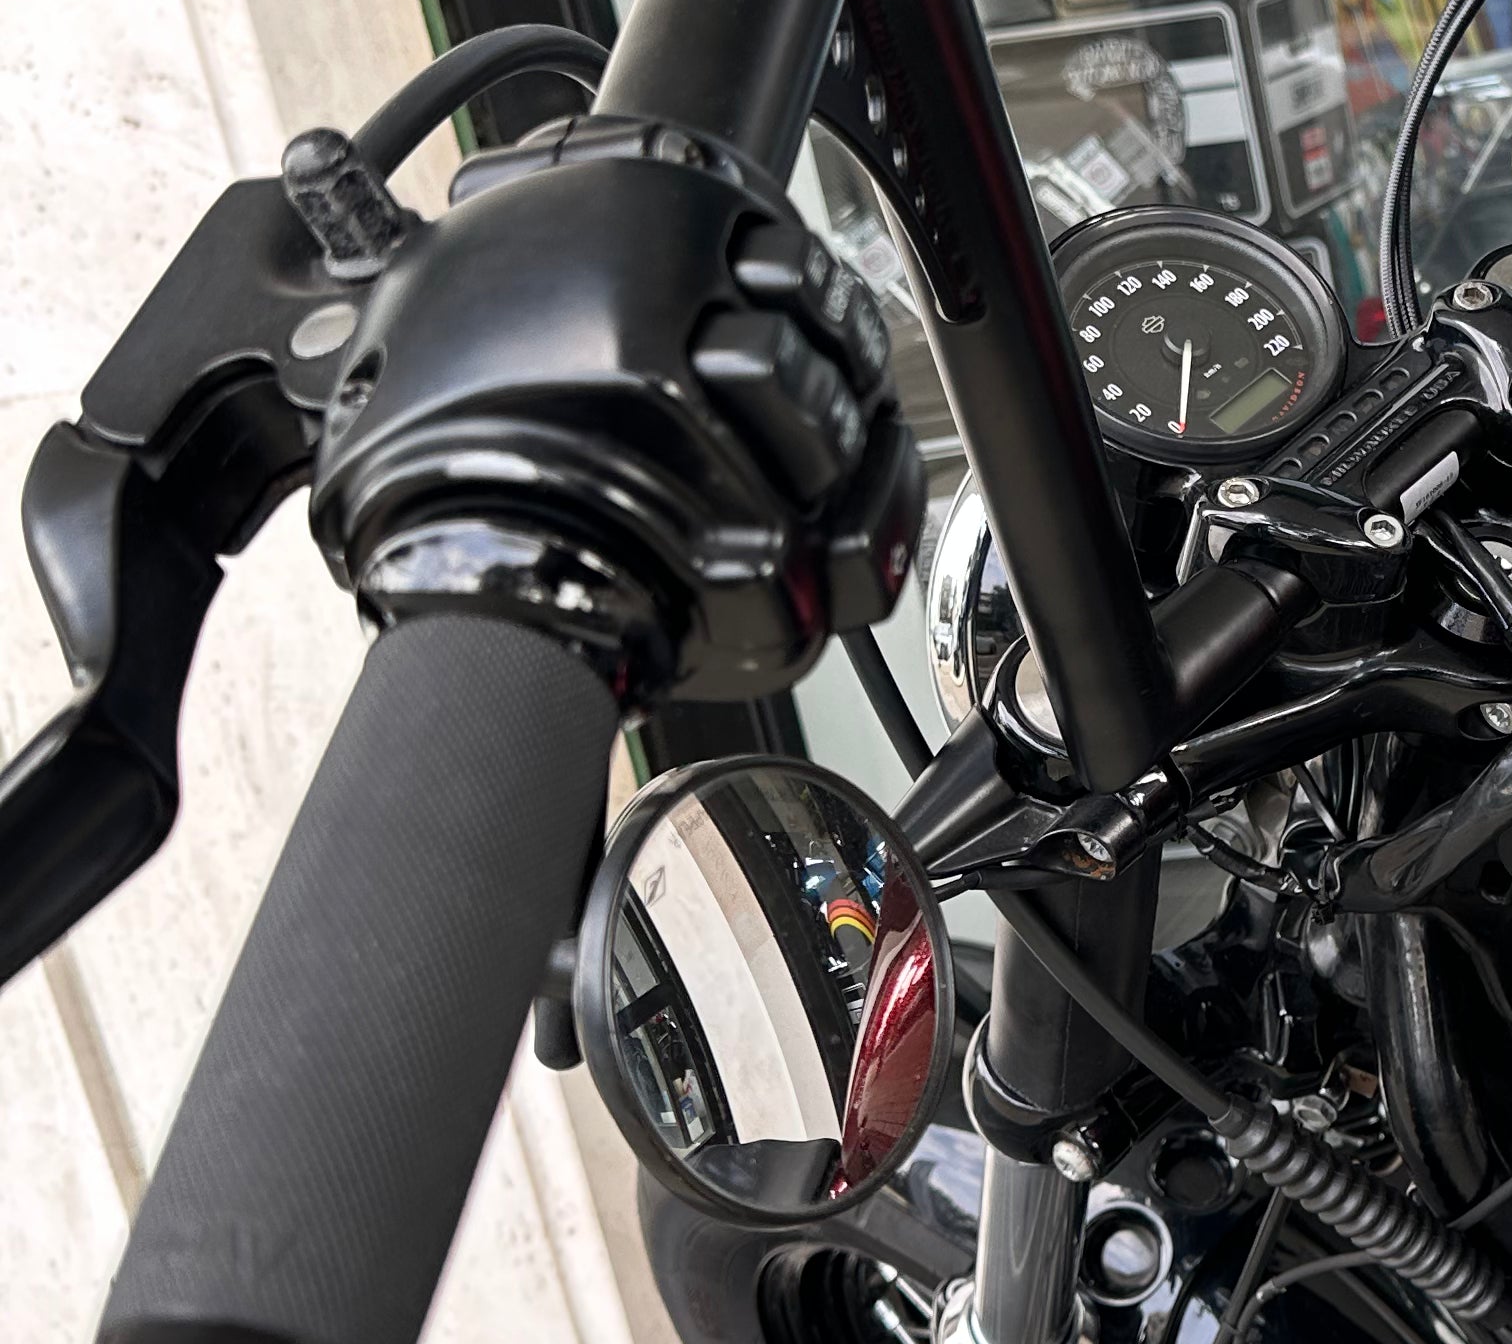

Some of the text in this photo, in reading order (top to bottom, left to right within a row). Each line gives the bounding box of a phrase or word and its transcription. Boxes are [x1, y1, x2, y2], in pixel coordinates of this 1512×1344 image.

[1117, 276, 1142, 297] 120
[1152, 270, 1177, 289] 140
[1190, 273, 1215, 293] 160
[1089, 297, 1115, 317] 100
[1225, 288, 1250, 307] 180
[1248, 308, 1275, 330] 200
[1080, 325, 1101, 342] 80
[1263, 335, 1290, 356] 220
[1083, 355, 1104, 373] 60
[1102, 384, 1122, 400] 40
[1130, 404, 1152, 422] 20
[1167, 420, 1181, 433] 0
